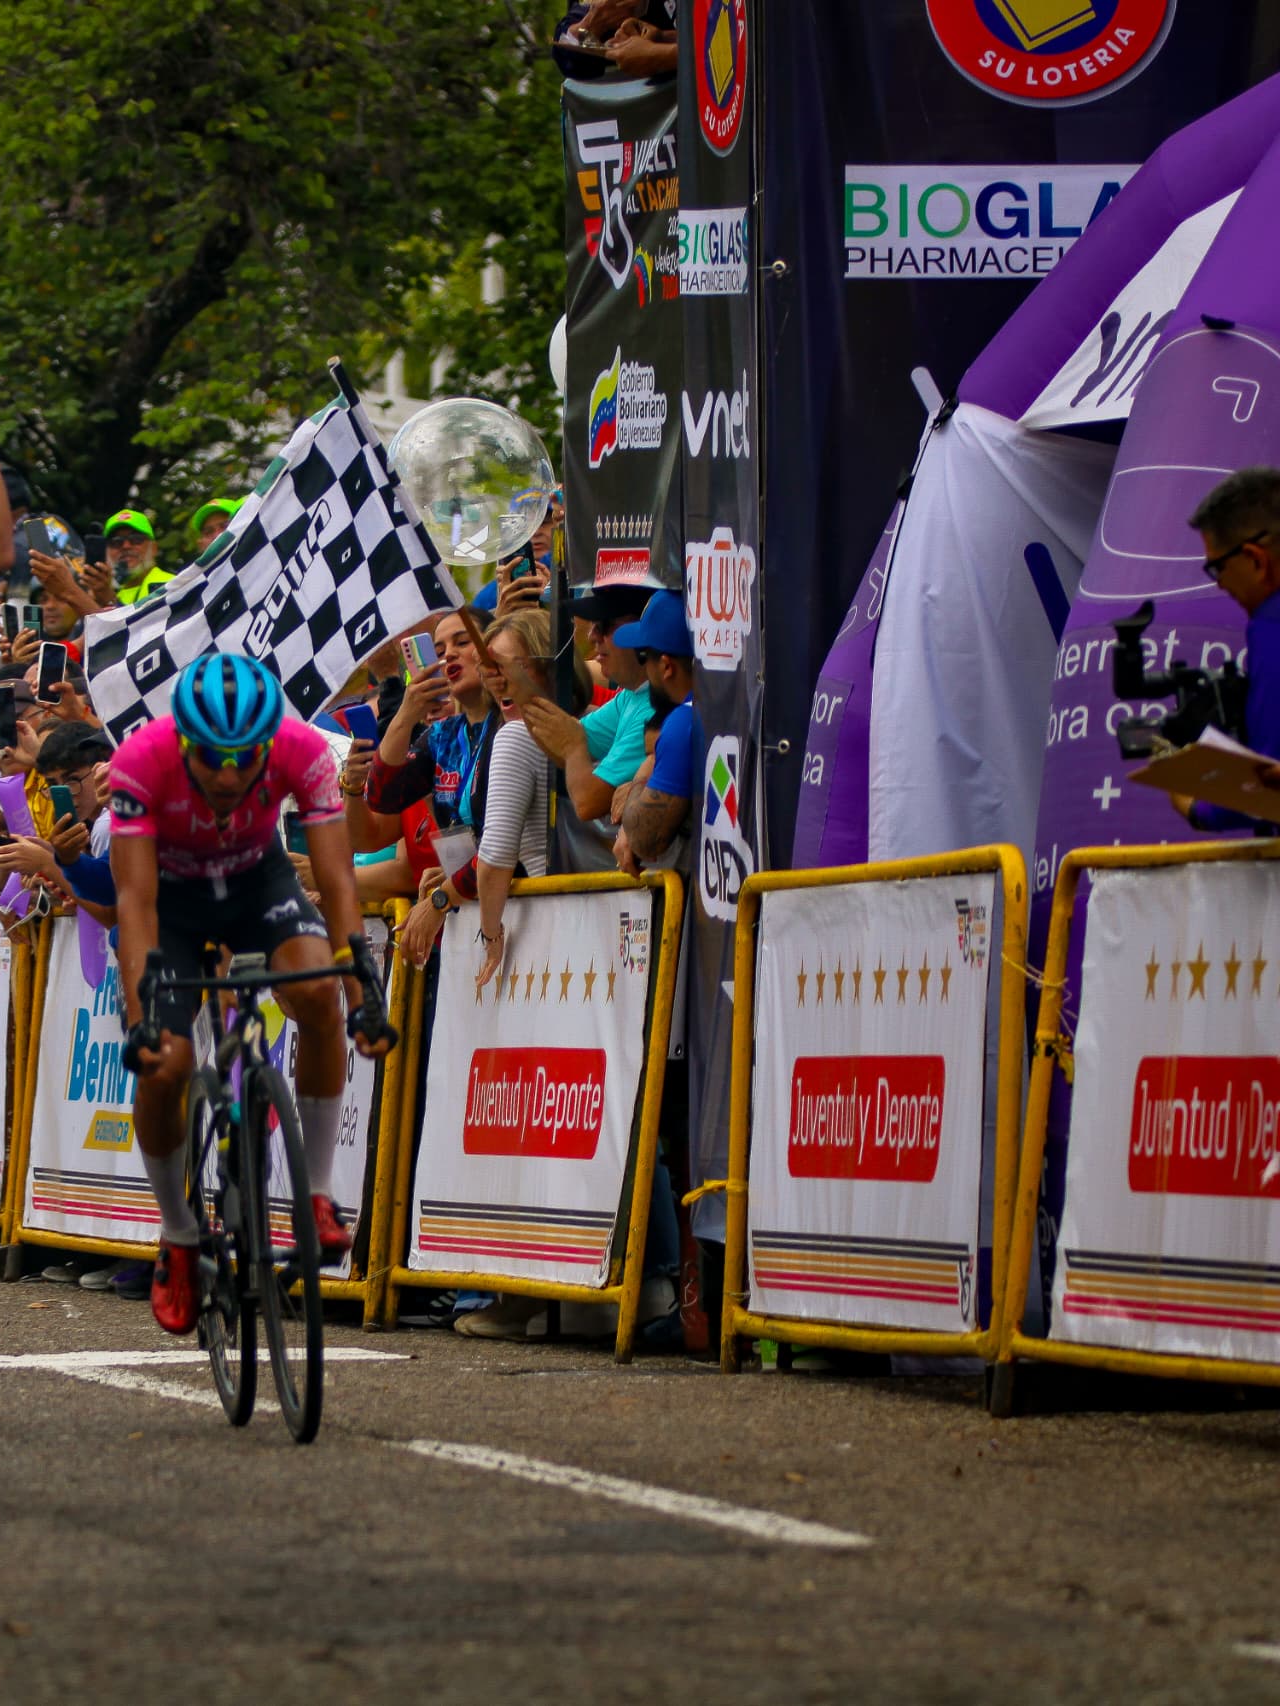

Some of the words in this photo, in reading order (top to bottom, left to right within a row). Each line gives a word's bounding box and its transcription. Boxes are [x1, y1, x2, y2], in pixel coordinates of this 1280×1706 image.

[978, 50, 1016, 79] SU
[1026, 25, 1136, 86] LOTERIA
[704, 105, 716, 131] SU
[632, 134, 677, 176] VUELT
[626, 194, 640, 214] AL
[620, 368, 654, 393] Gobierno
[620, 394, 666, 420] Bolivariano
[681, 368, 749, 458] vnet
[619, 422, 628, 442] de
[629, 422, 661, 442] Venezuela
[699, 628, 738, 649] KAFE
[466, 1066, 521, 1129] Juventud
[520, 1082, 532, 1143] y
[531, 1066, 602, 1144] Deporte
[791, 1075, 857, 1147] Juventud
[857, 1090, 872, 1164] y
[874, 1077, 941, 1168] Deporte
[1233, 1101, 1247, 1180] y
